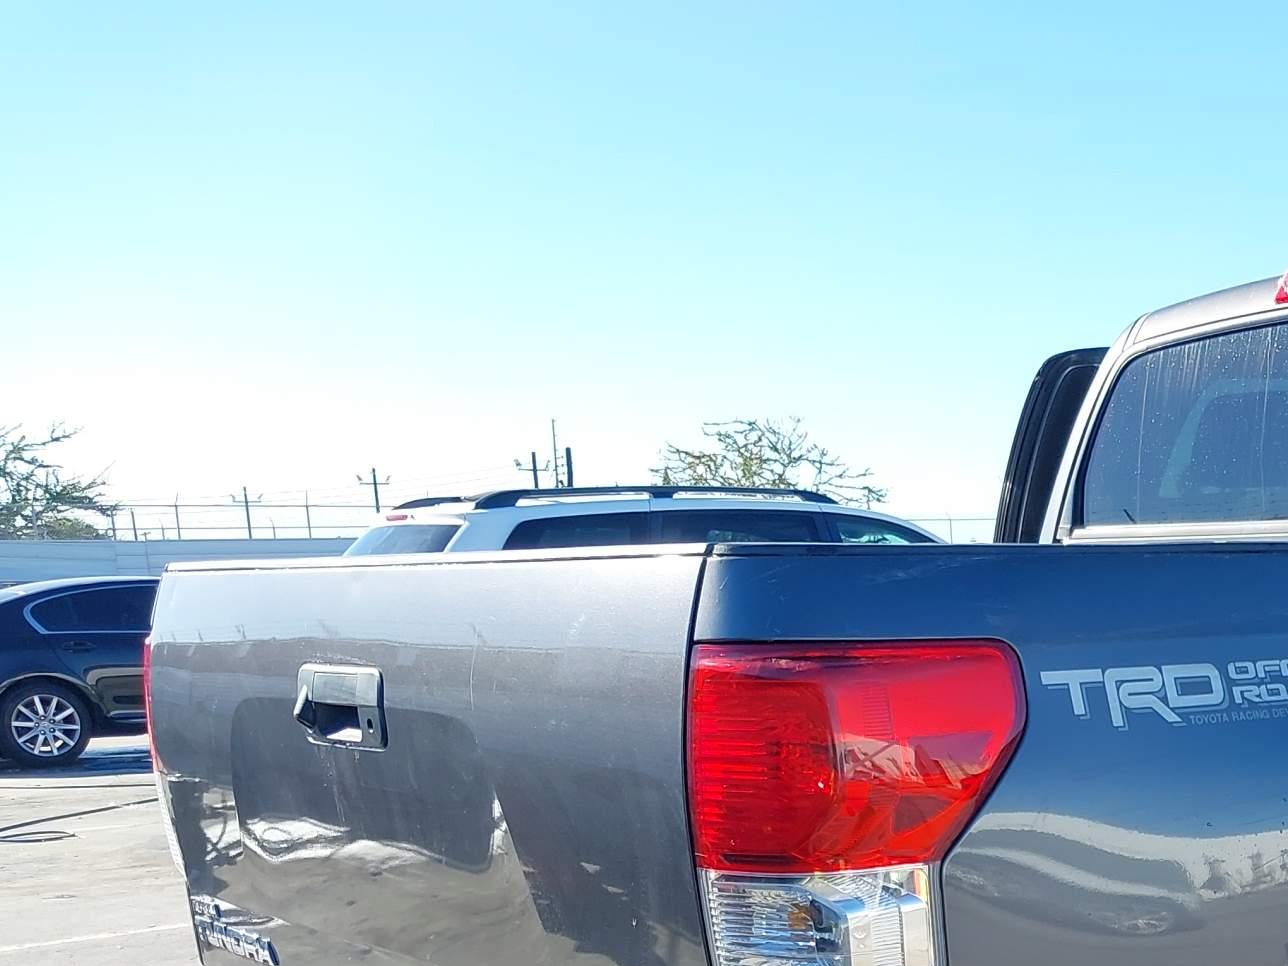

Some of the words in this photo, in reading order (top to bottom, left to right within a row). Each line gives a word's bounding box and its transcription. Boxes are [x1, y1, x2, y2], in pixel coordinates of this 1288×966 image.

[1039, 662, 1229, 730] TRD
[1189, 714, 1229, 726] TOYOTA
[1231, 709, 1270, 722] RACING
